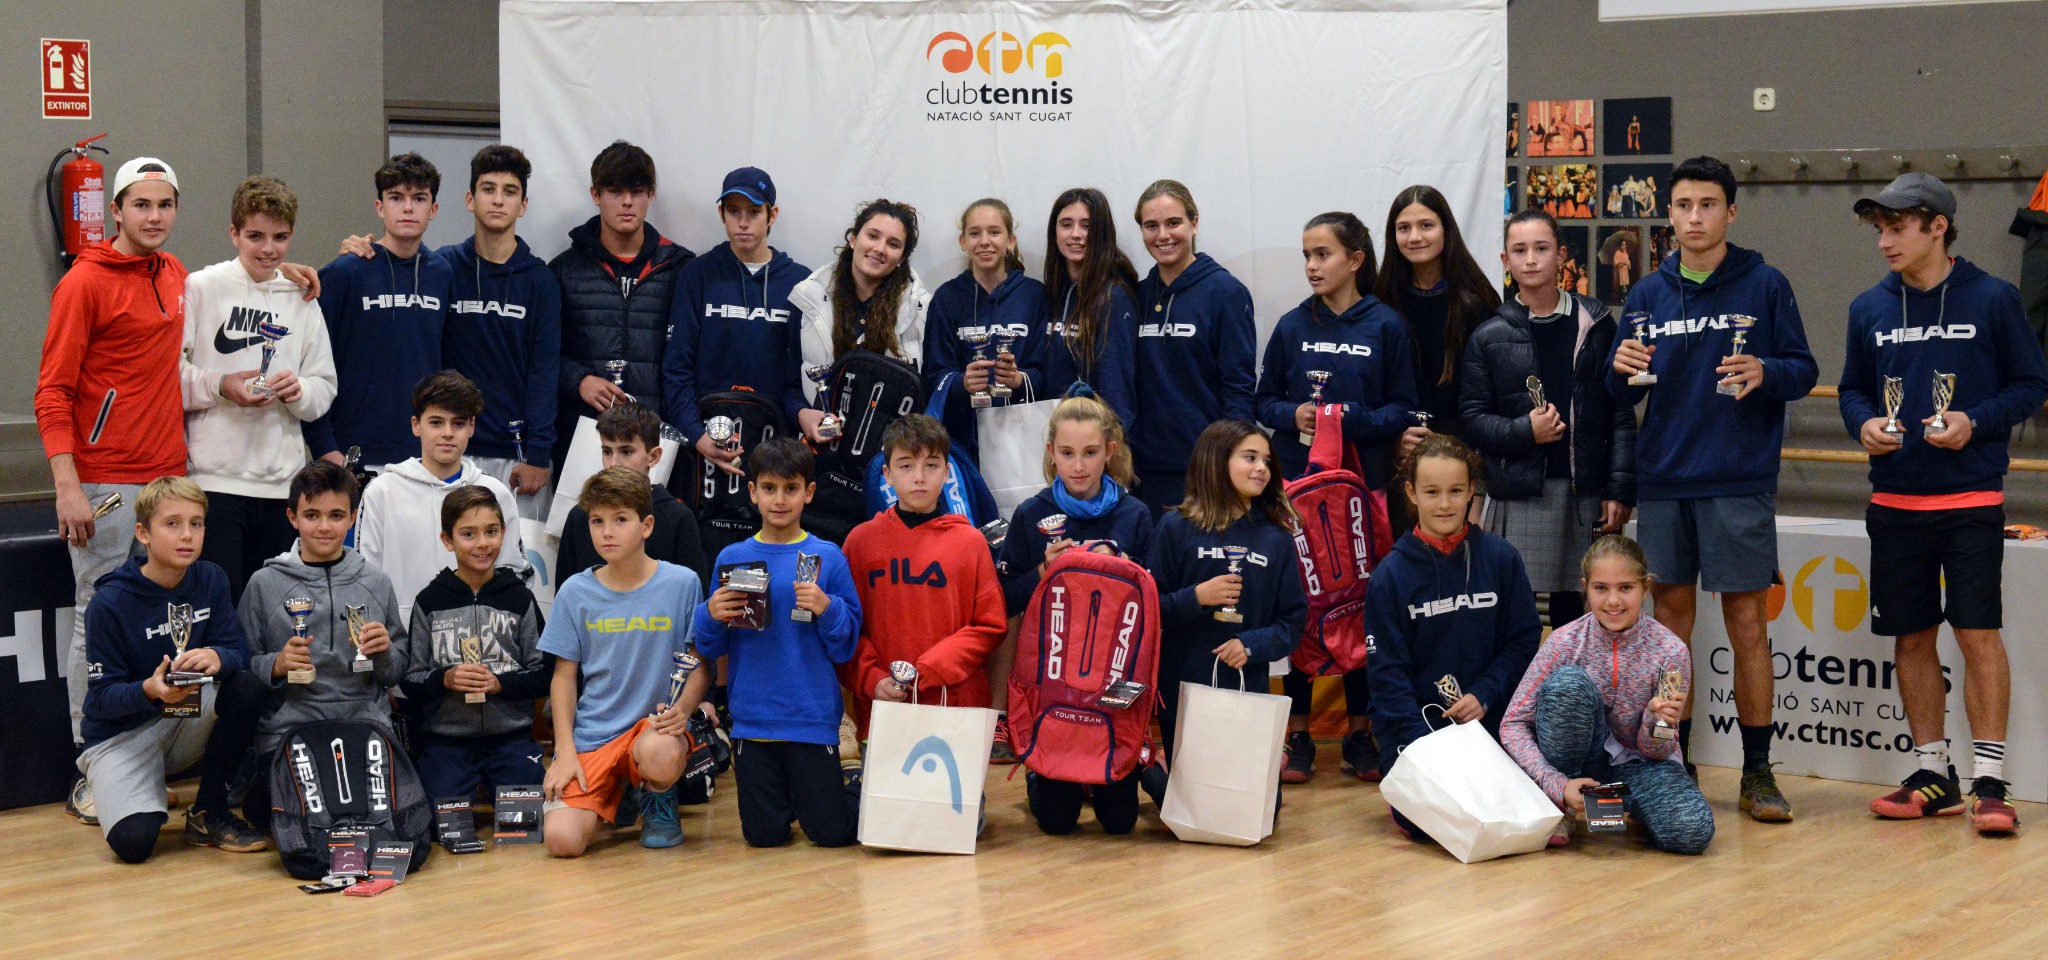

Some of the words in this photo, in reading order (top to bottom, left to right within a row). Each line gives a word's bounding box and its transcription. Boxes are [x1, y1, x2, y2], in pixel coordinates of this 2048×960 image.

[926, 81, 1073, 105] clubtennis
[47, 101, 87, 111] EXTINTOR
[927, 110, 983, 122] NATACIÓ
[989, 112, 1022, 122] SANT
[1029, 112, 1073, 122] CUGAT
[362, 293, 441, 310] HEAD
[226, 306, 278, 335] NIK
[705, 303, 791, 323] HEAD
[1138, 323, 1196, 338] EAD
[1875, 324, 1977, 346] HEAD
[1301, 341, 1372, 357] HEAD
[829, 474, 848, 487] TOUR
[947, 462, 967, 515] EAD
[711, 521, 731, 530] TOUR
[1350, 496, 1370, 579] HEAD
[1197, 546, 1268, 567] HD
[868, 558, 948, 588] FILA
[1328, 608, 1347, 621] TOUR
[1407, 591, 1498, 620] HEAD
[489, 611, 517, 635] NYC
[585, 616, 673, 634] HEAD
[1047, 586, 1065, 680] HEAD
[1105, 601, 1139, 690] HEAD
[1709, 638, 1952, 695] cbten
[1710, 687, 1799, 711] NAIÓ
[1810, 697, 1865, 717] SANT
[1054, 710, 1076, 722] TOUR
[1079, 715, 1102, 724] TEAM
[1709, 714, 1951, 763] ww.ctnsc.o
[292, 743, 323, 813] HEAD
[368, 739, 388, 811] HEAD
[686, 761, 715, 779] HEAD
[437, 801, 470, 810] HEAD
